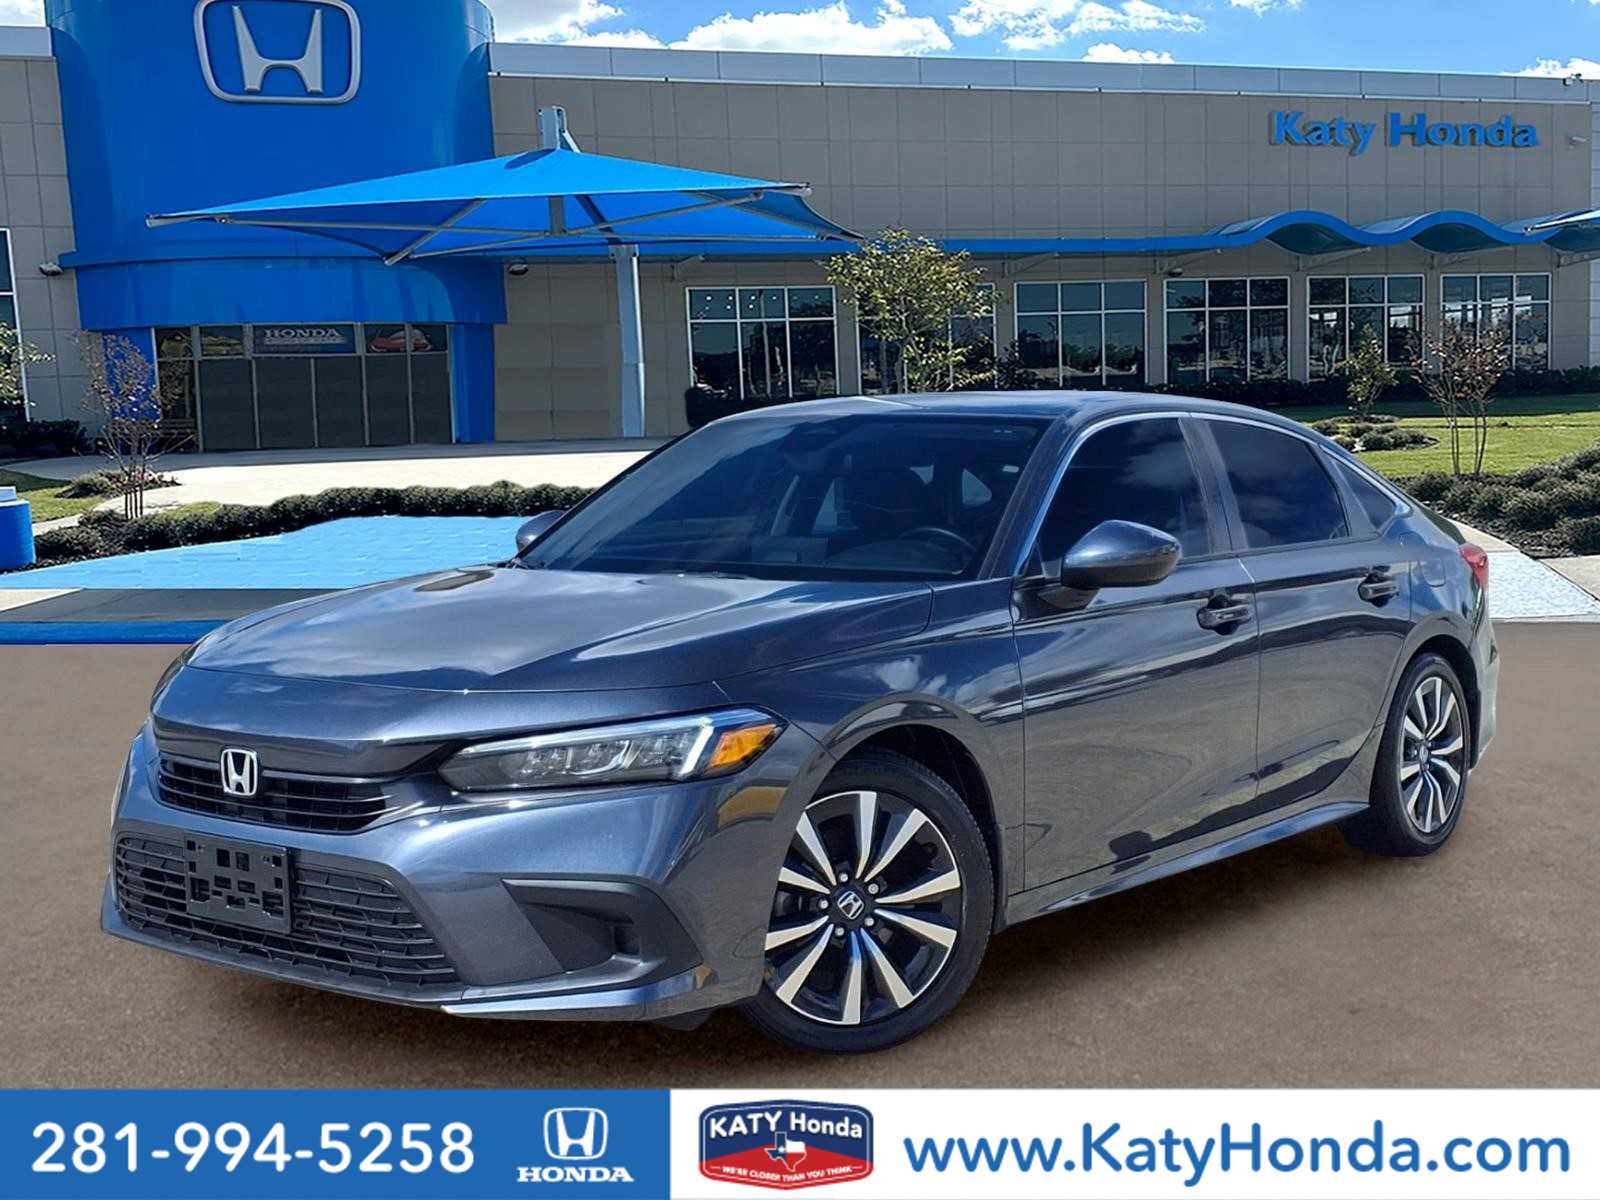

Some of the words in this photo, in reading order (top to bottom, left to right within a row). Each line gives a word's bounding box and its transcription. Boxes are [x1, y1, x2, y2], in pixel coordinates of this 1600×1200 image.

[1270, 111, 1376, 156] Katy
[1386, 112, 1539, 148] Honda
[264, 328, 342, 338] HONDA
